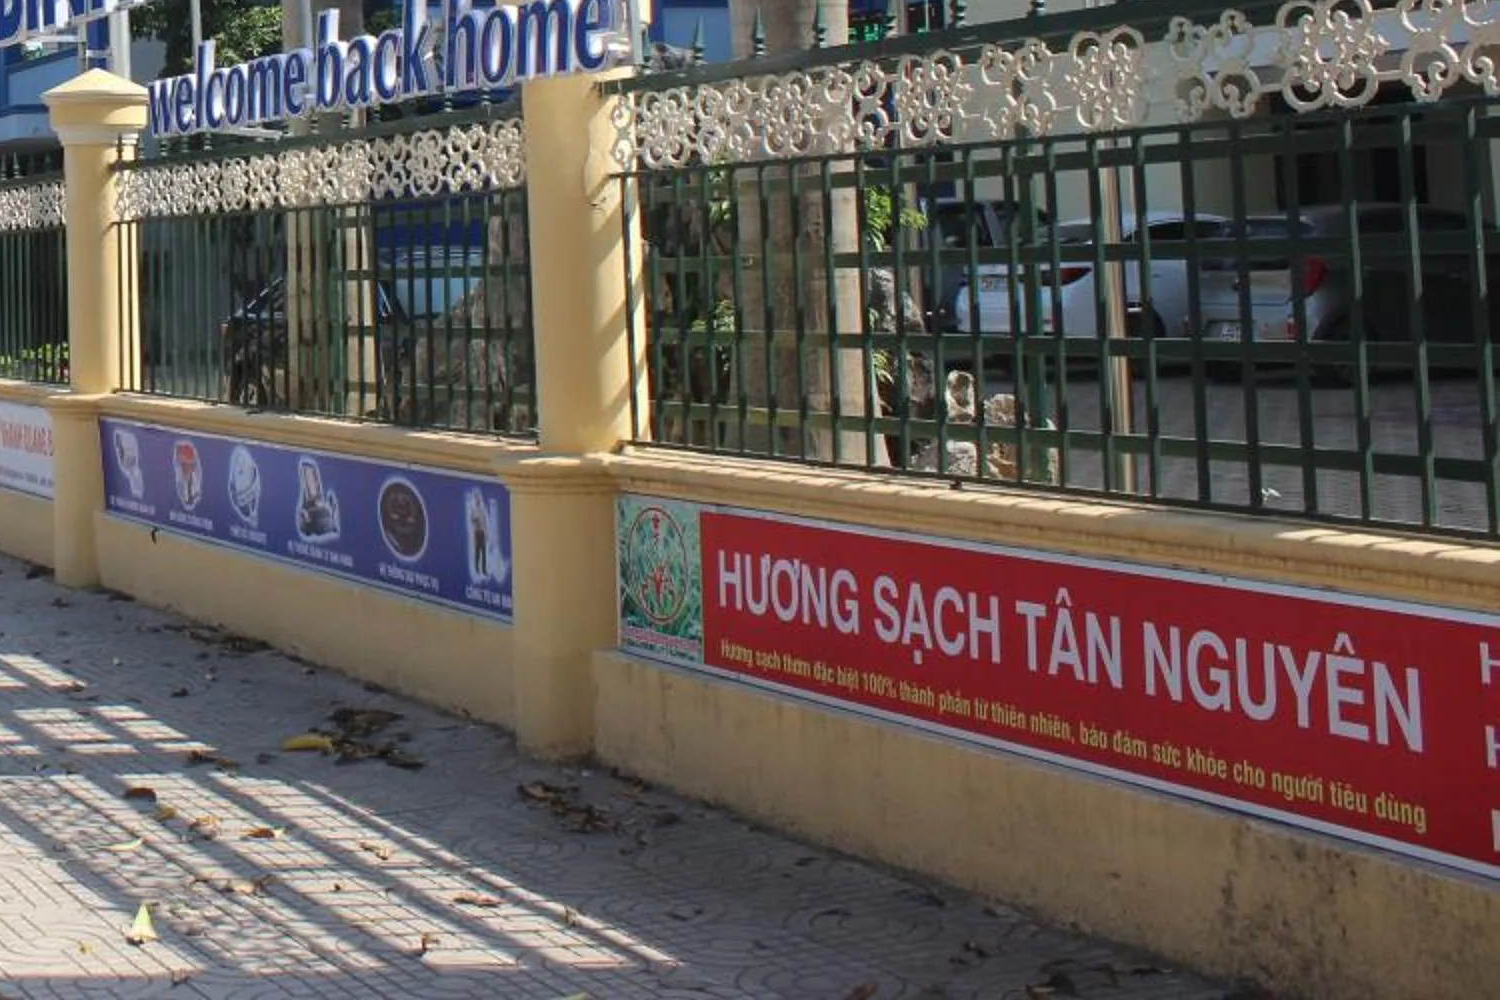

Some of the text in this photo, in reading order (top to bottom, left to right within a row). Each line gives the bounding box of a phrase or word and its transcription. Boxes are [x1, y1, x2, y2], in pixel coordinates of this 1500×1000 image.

[147, 40, 312, 138] welcome
[717, 549, 1424, 754] HƯƠNG SẠCH TÂN NGUYÊN
[863, 671, 898, 700] 100%
[991, 700, 1027, 731] thiên
[1232, 759, 1266, 790] cho
[1374, 790, 1428, 835] dùng
